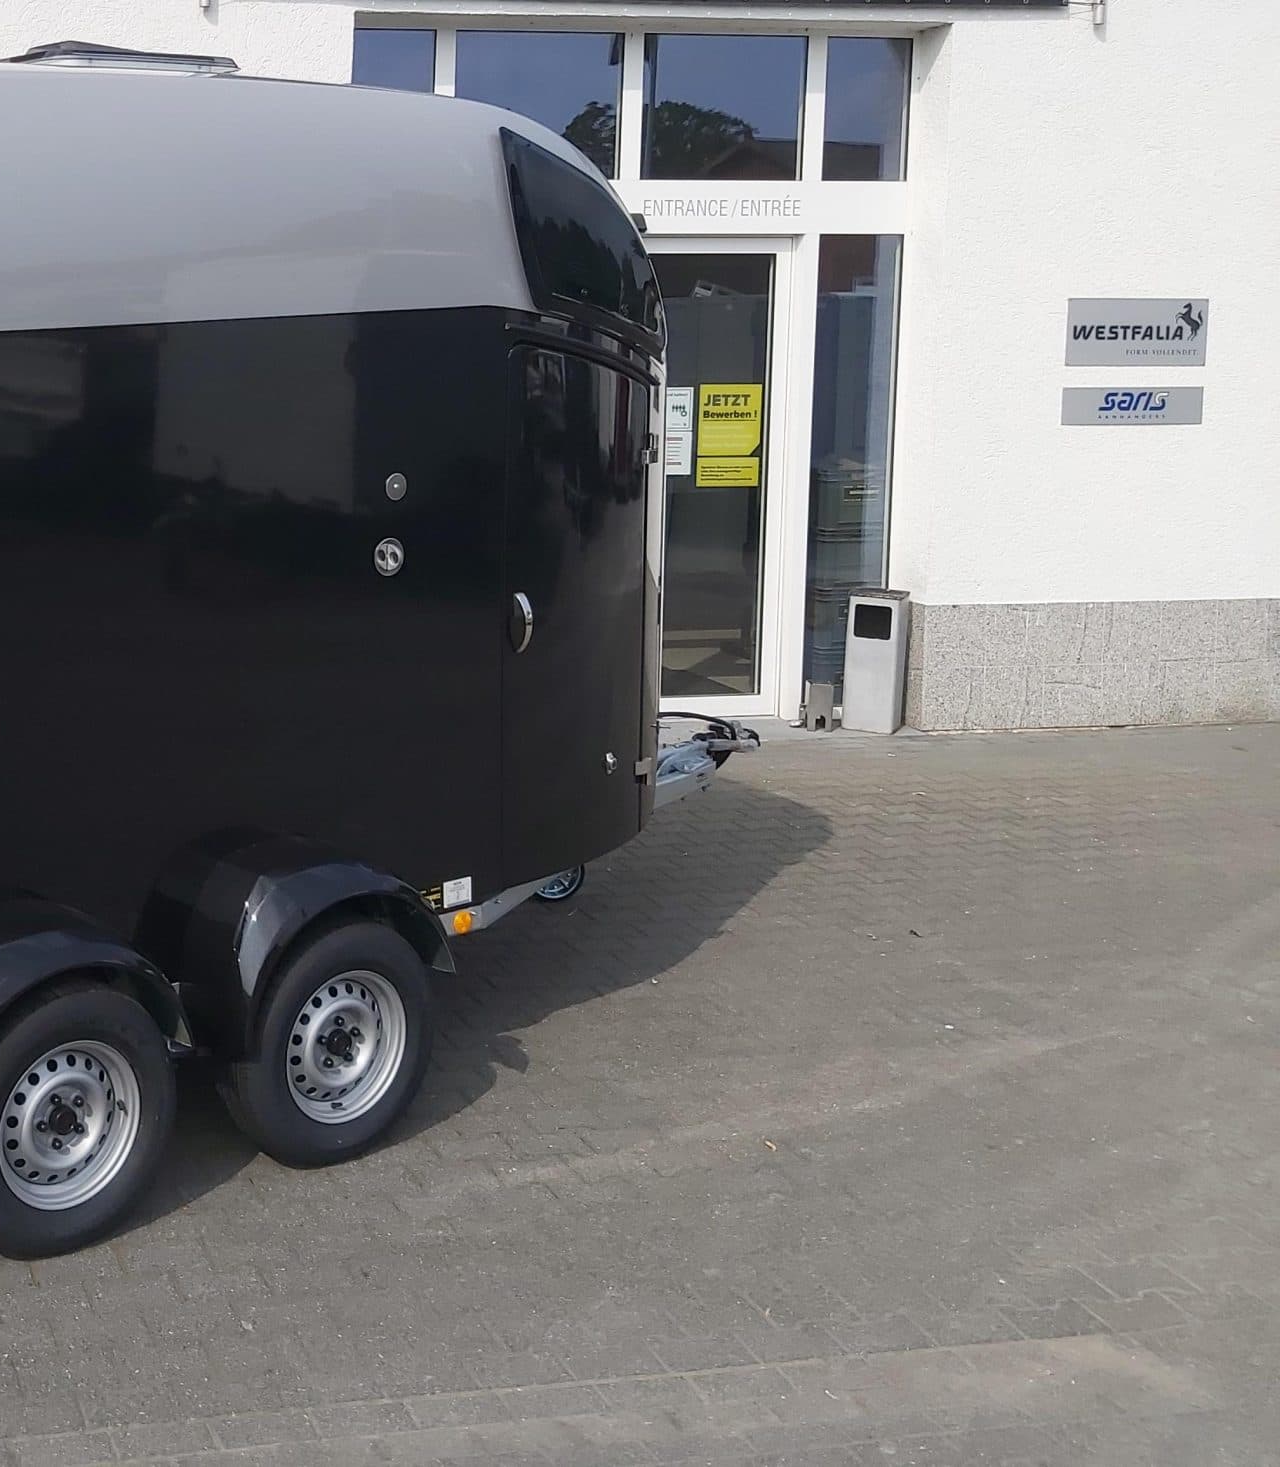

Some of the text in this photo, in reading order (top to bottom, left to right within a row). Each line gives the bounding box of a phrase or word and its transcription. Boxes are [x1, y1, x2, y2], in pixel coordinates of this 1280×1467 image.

[1072, 325, 1184, 341] WESTFALIA
[703, 394, 751, 407] JETZT
[703, 410, 752, 418] Bewerben
